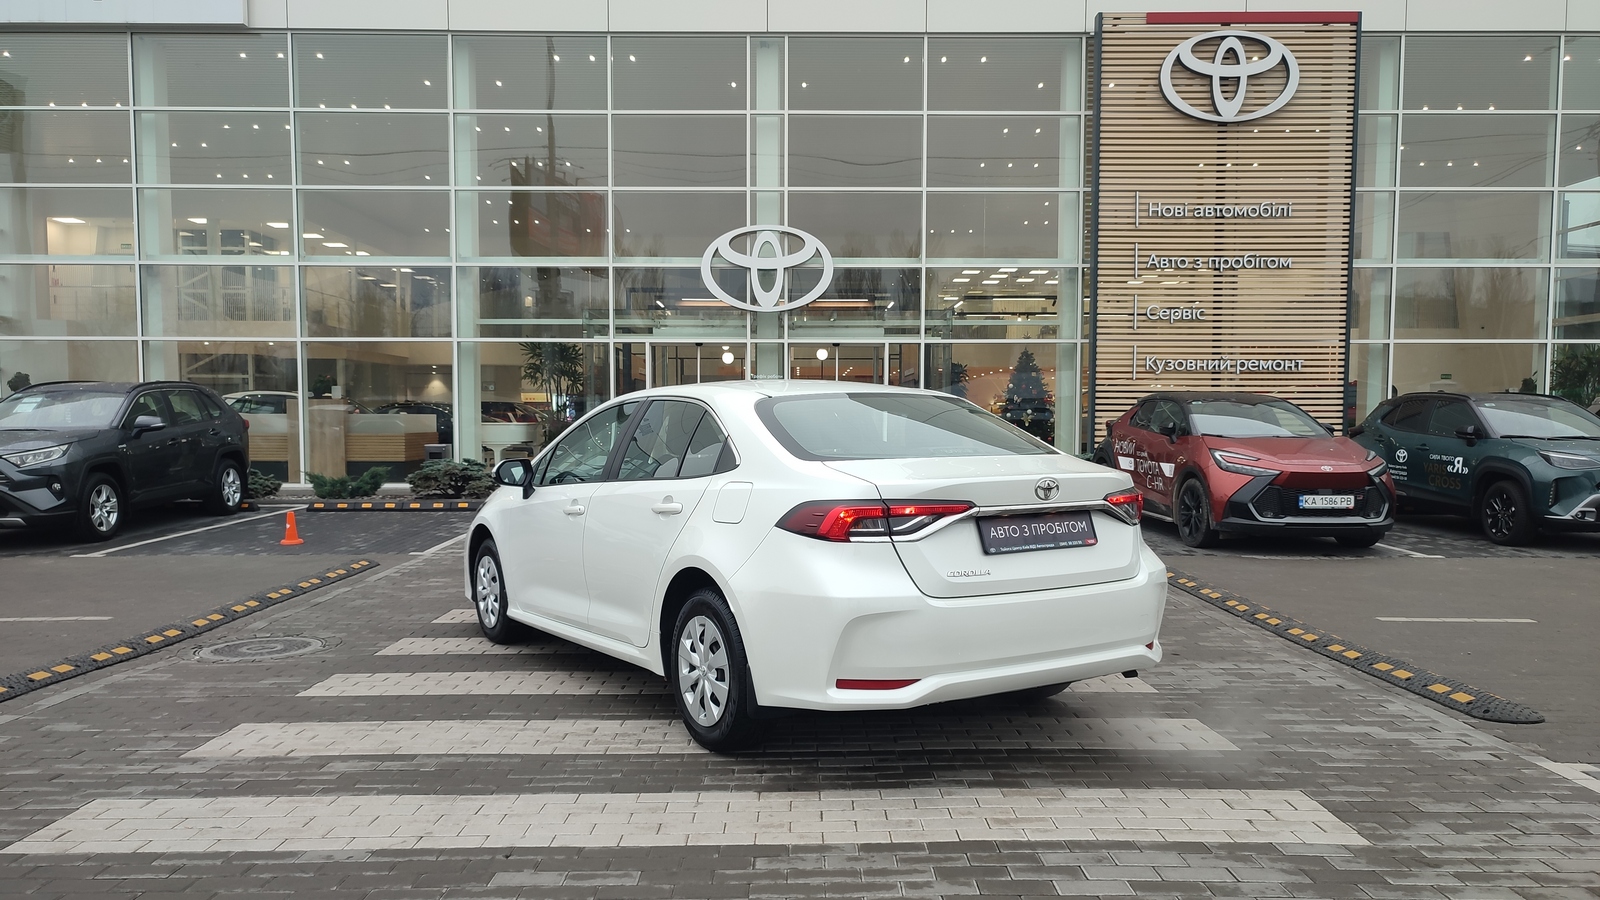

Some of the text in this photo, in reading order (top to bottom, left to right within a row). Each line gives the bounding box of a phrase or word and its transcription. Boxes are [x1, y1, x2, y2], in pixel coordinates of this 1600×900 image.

[1148, 202, 1293, 218] Нові автомобілі
[1146, 253, 1293, 272] Авто з пробігом
[1146, 305, 1207, 324] Сервіс
[1145, 355, 1305, 375] Кузовний ремонт
[1136, 459, 1160, 475] TOYOTA
[1423, 462, 1447, 475] YARIS
[1146, 475, 1164, 490] C-HR
[1428, 474, 1462, 490] CROSS
[1319, 496, 1338, 506] 1586
[990, 525, 1020, 539] АВТО
[1031, 521, 1088, 536] ПРОБІГОМ
[946, 569, 991, 578] COROLLA
